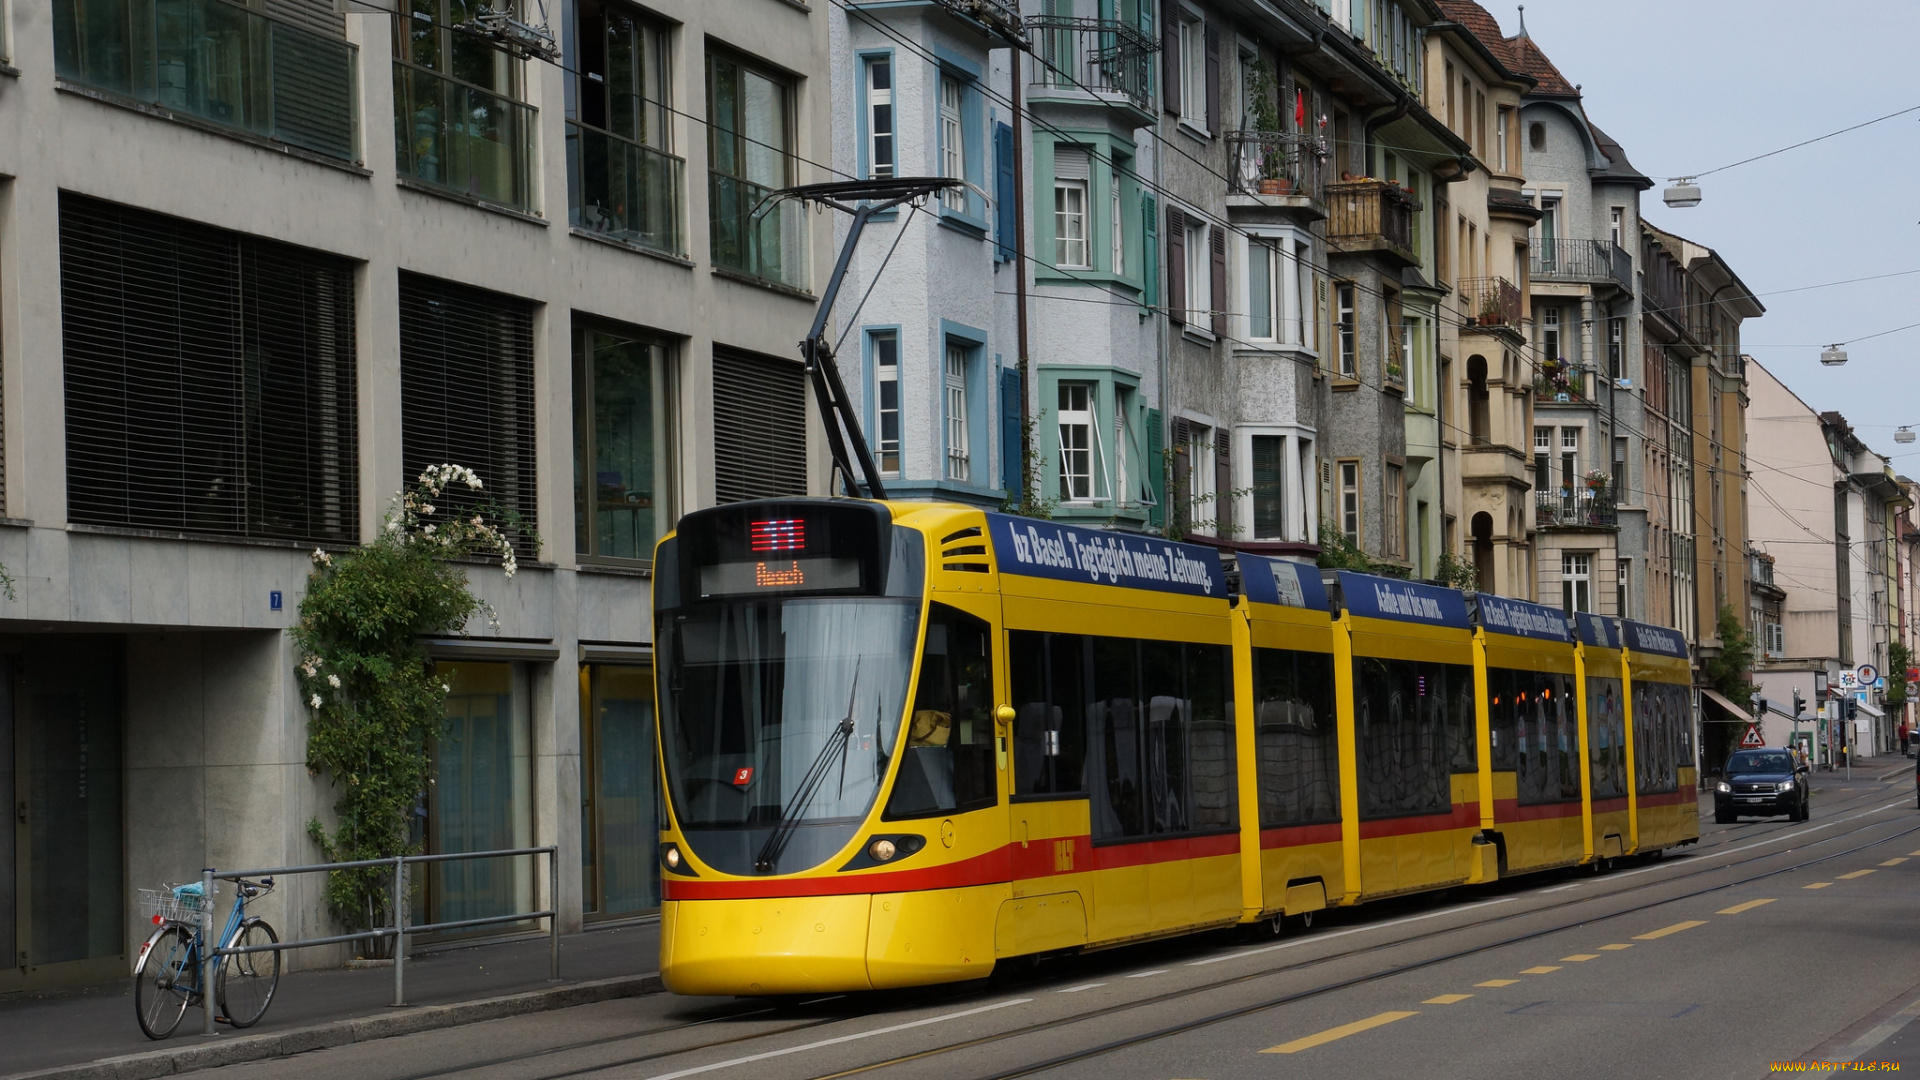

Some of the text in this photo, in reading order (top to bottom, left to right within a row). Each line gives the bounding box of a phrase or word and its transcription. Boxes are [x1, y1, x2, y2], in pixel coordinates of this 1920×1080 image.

[763, 520, 794, 550] 11
[1009, 522, 1213, 594] bz Basel. Tagtäglich meine Zeitung.
[757, 560, 803, 585] Aesch
[273, 593, 279, 607] 7
[1396, 587, 1413, 615] und
[1407, 587, 1424, 617] bis
[739, 769, 749, 780] 3
